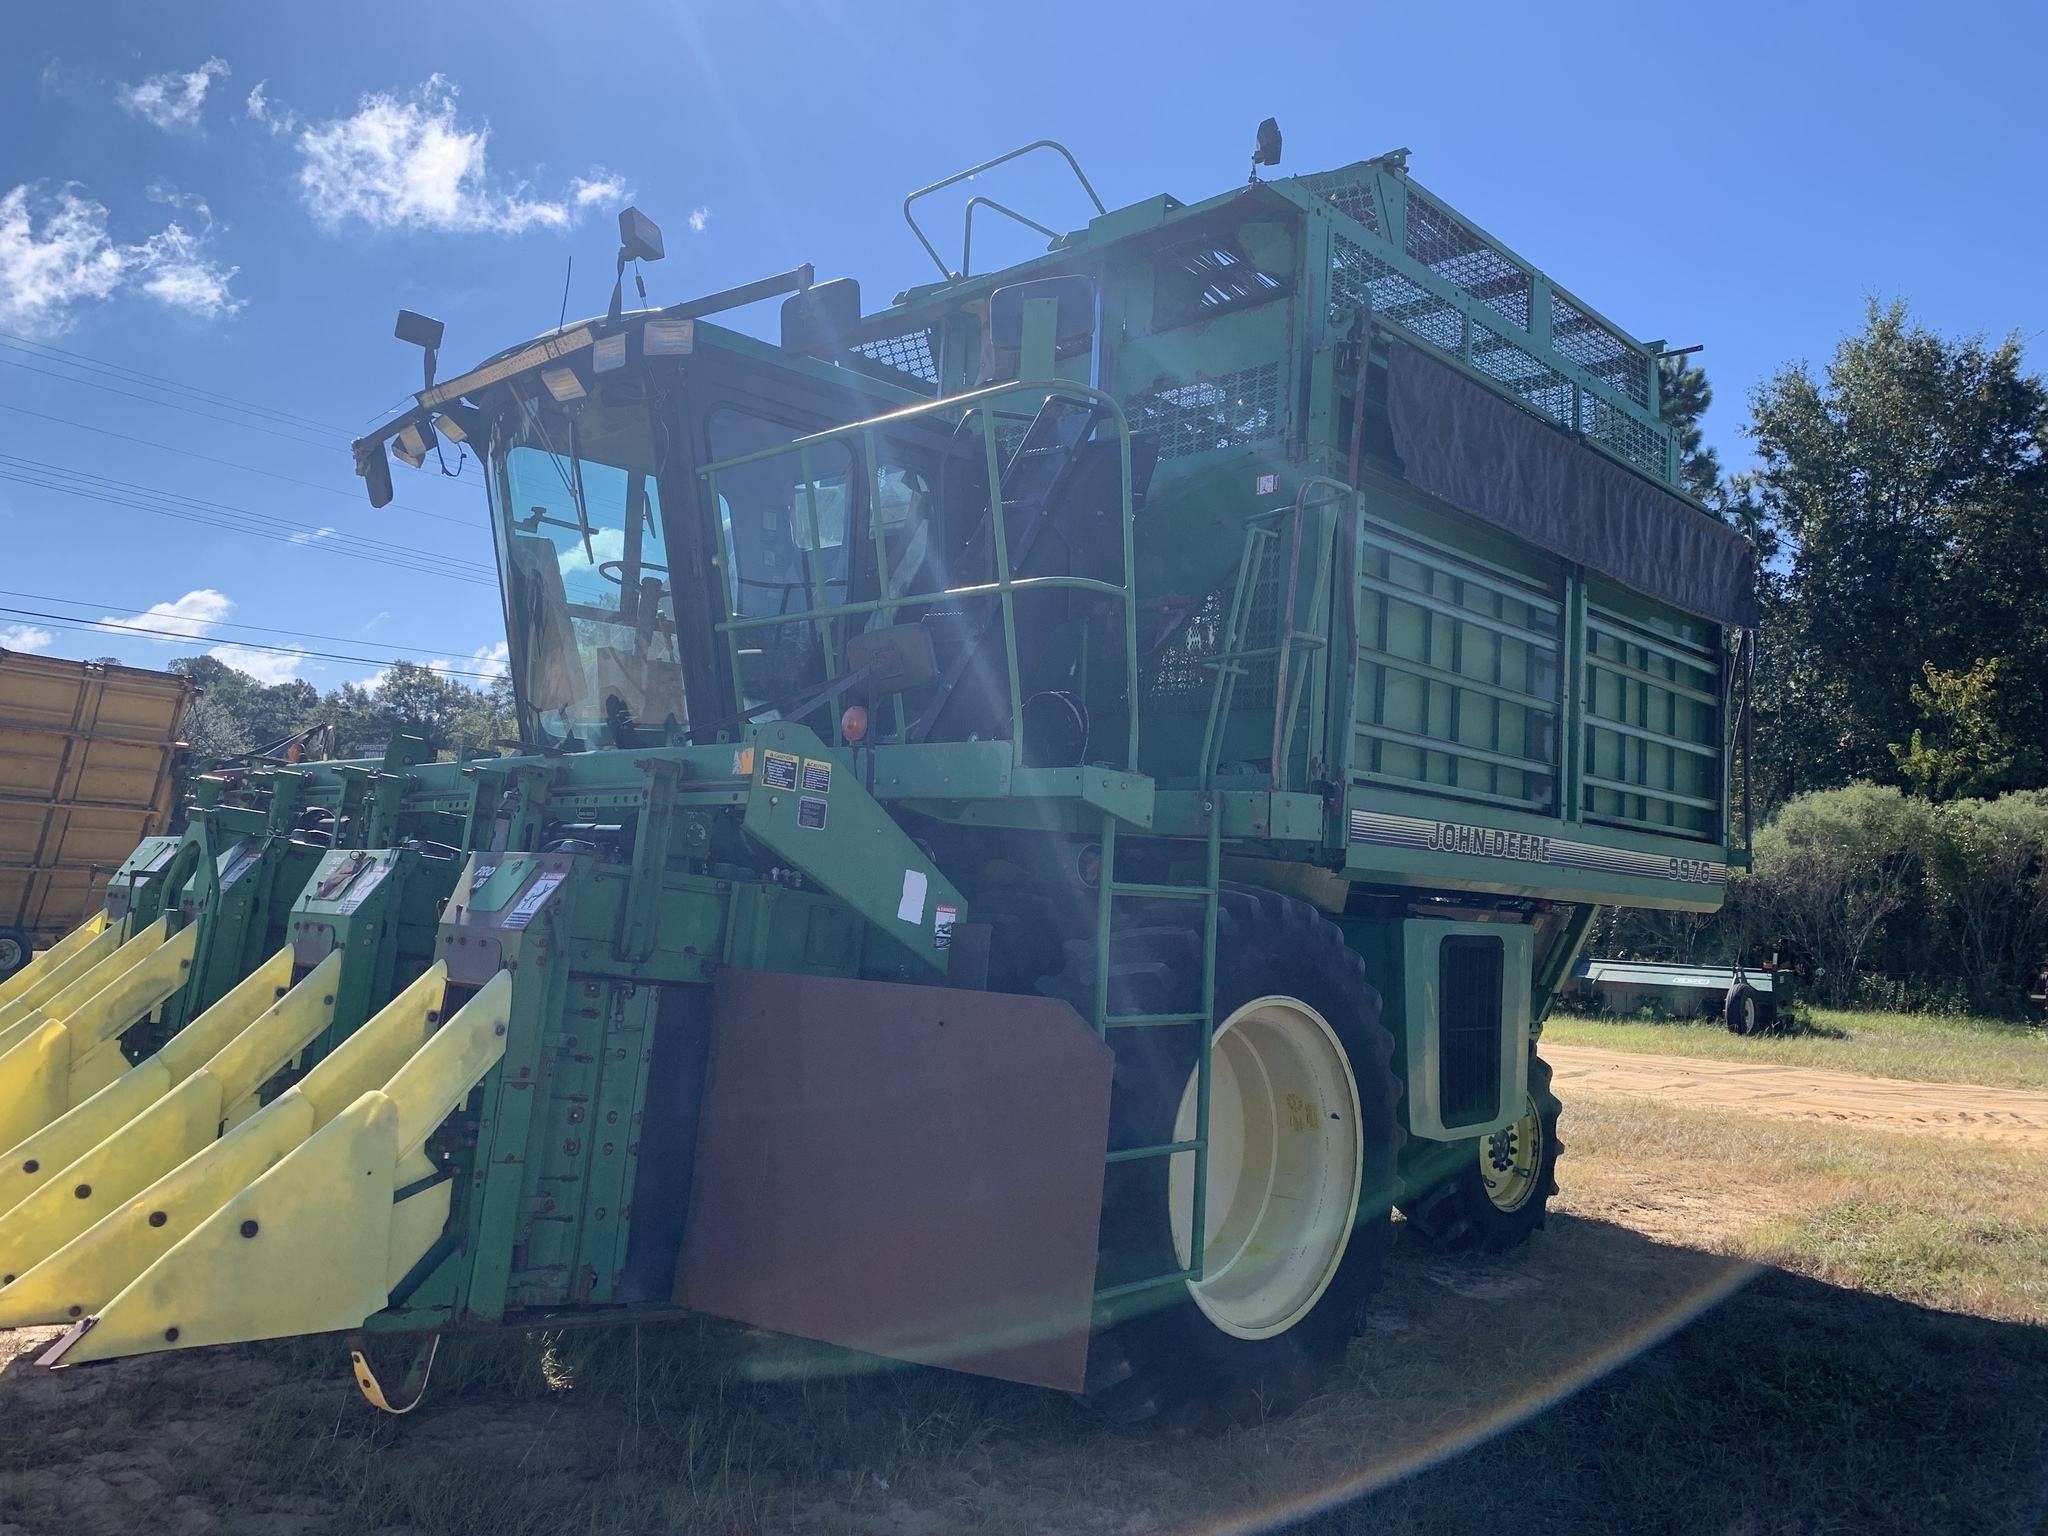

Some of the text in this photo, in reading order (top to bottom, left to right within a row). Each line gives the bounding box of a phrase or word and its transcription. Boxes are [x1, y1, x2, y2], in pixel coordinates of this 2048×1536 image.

[774, 753, 794, 761] CAUTION
[1428, 822, 1551, 863] JOHN DEERE
[474, 865, 497, 877] PRO
[1669, 857, 1711, 883] 9976
